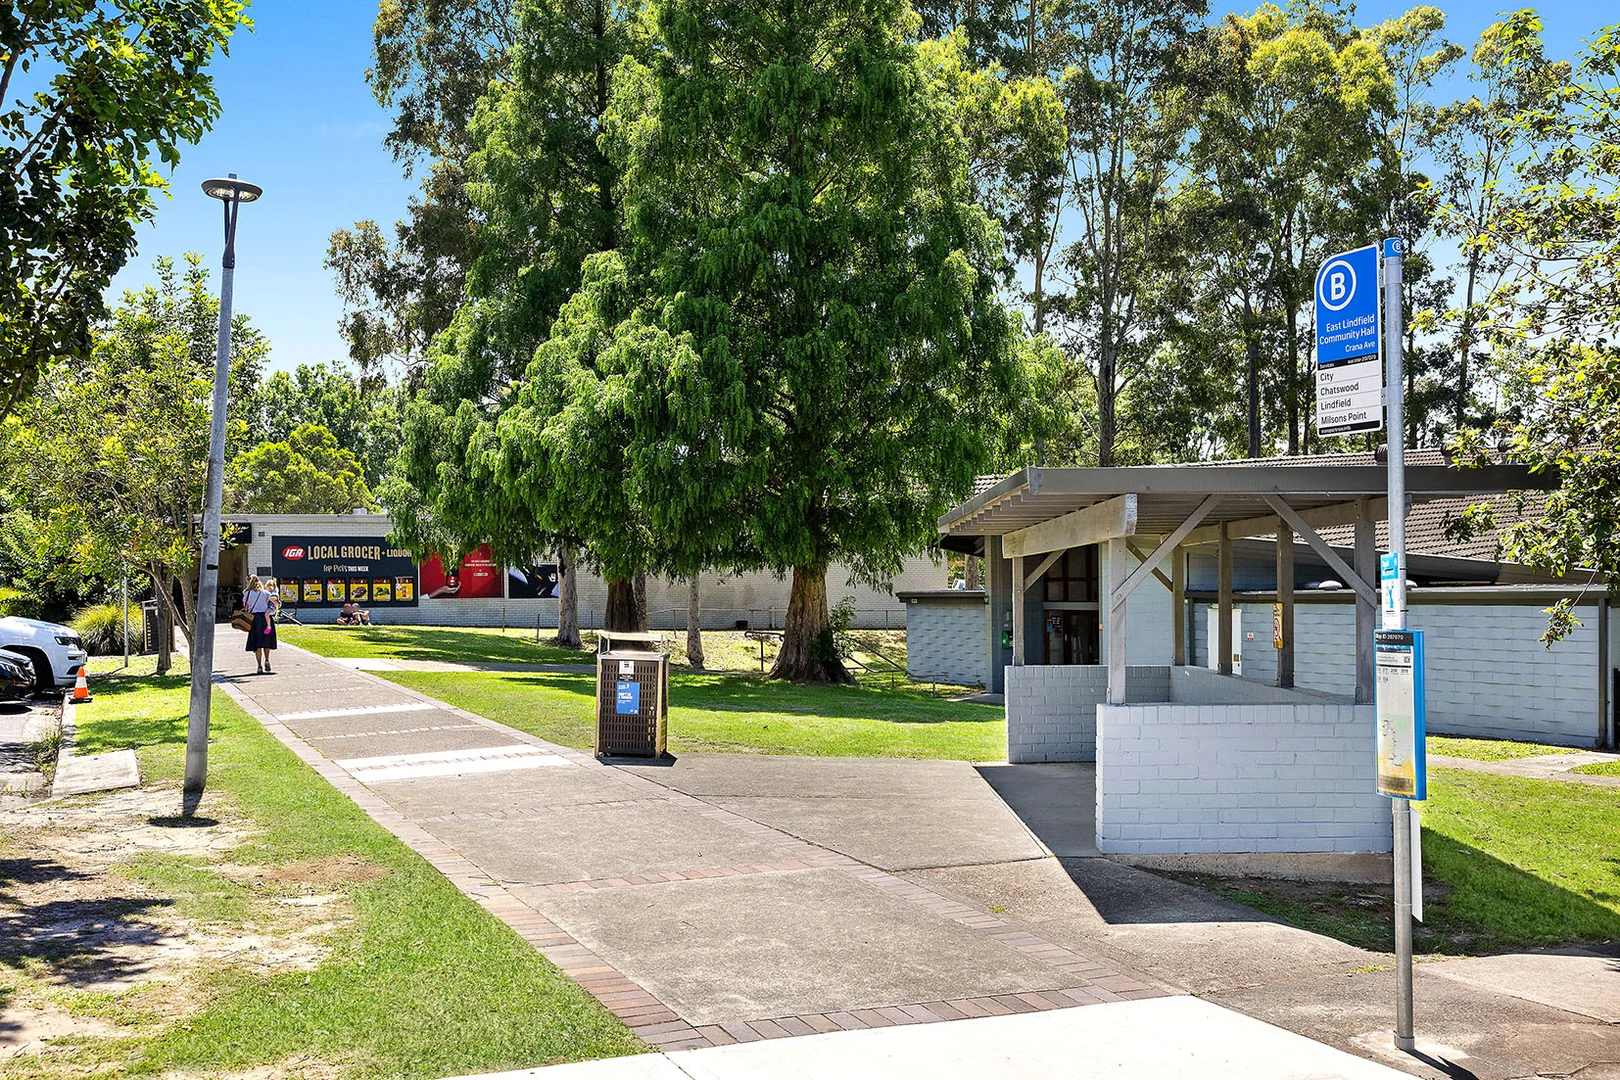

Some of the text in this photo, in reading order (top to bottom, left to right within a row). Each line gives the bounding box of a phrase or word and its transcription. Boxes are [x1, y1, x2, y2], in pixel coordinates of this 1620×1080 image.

[1331, 272, 1346, 300] B
[1326, 314, 1375, 332] East Lindfield
[1320, 326, 1375, 345] Community Hall
[1345, 340, 1376, 352] Crana Ave
[1320, 372, 1334, 382] City
[1320, 382, 1359, 396] Chatswood
[1320, 398, 1352, 410] Lindfield
[1321, 412, 1366, 425] Milsons Point
[284, 548, 304, 557] IGA
[308, 546, 340, 560] LOCAL
[341, 546, 380, 560] GROCER
[386, 549, 412, 557] LIQUOR
